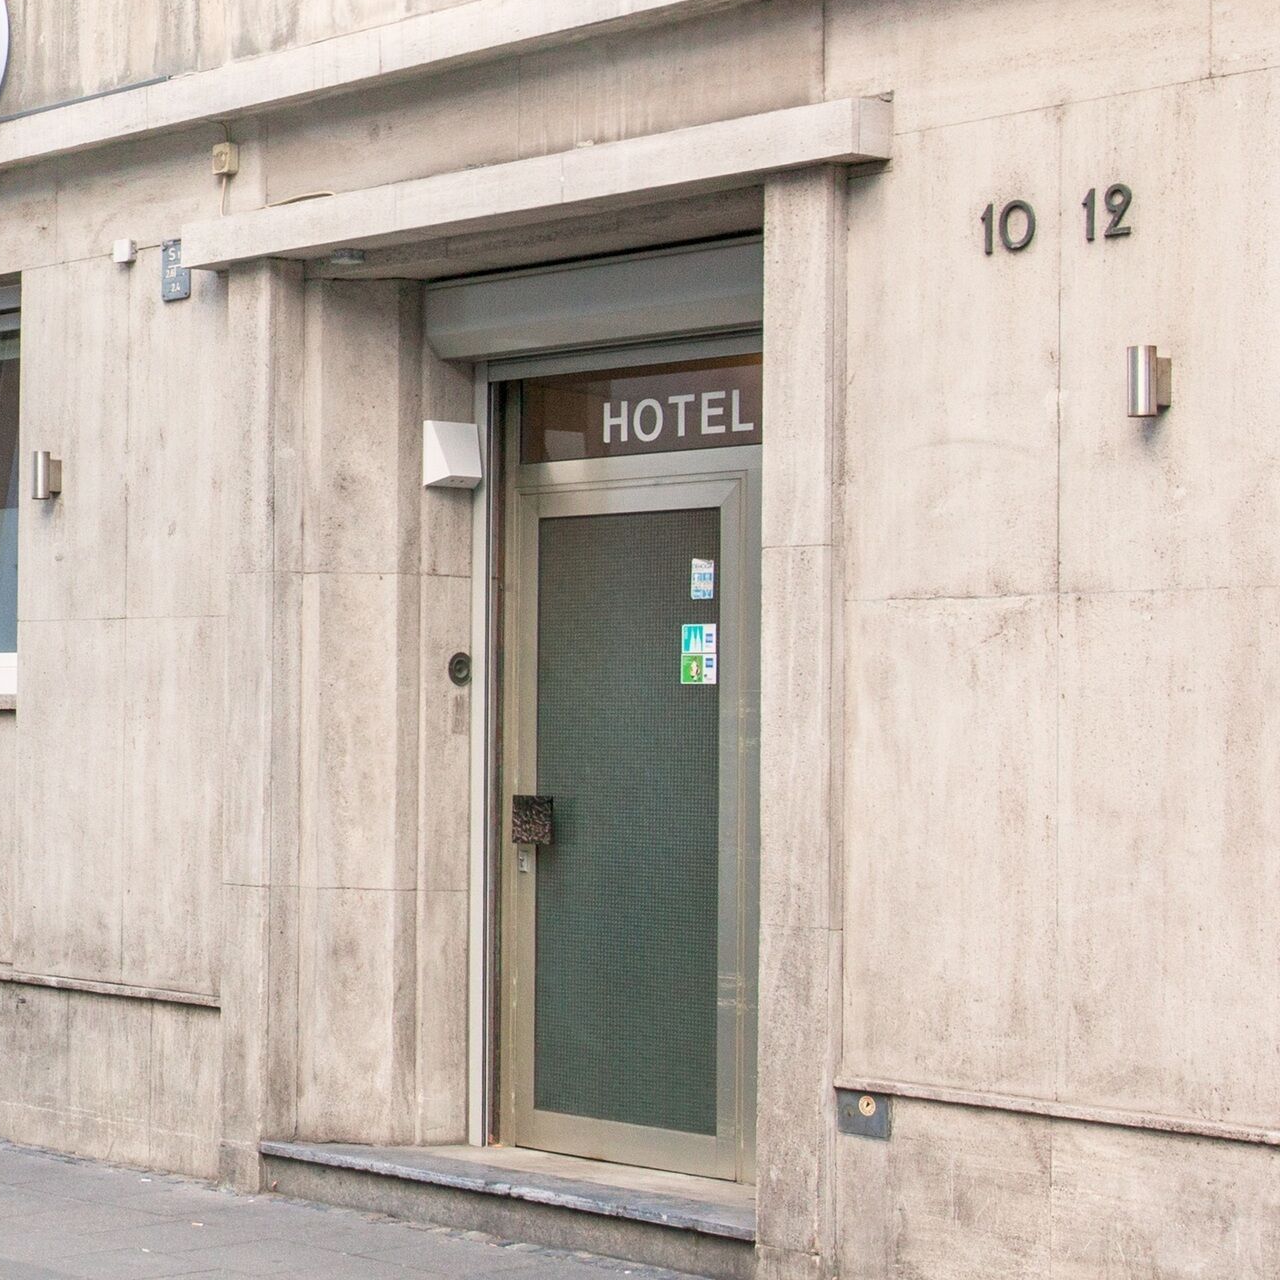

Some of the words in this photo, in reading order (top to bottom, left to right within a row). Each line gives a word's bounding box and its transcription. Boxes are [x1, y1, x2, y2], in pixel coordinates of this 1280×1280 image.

[981, 199, 1036, 255] 10
[1081, 183, 1132, 242] 12
[603, 389, 754, 443] HOTEL
